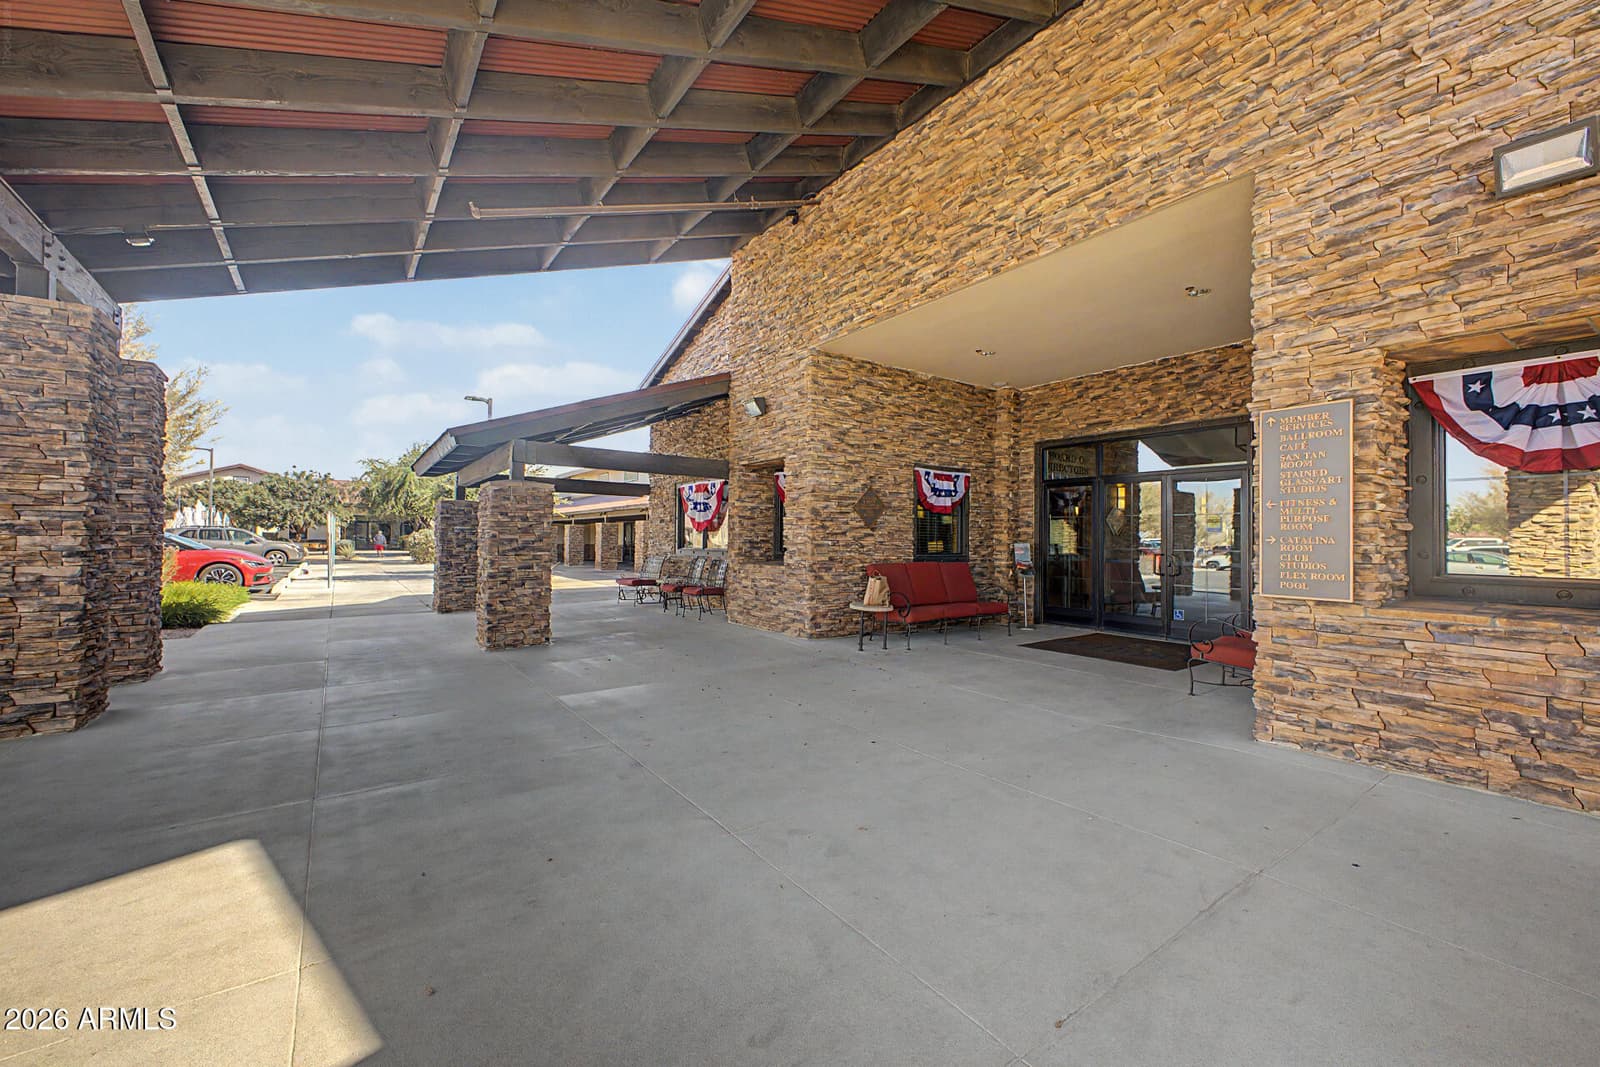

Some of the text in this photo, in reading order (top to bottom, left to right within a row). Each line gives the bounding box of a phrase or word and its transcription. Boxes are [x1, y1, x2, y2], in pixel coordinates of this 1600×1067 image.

[1280, 412, 1329, 424] MEMBER
[1280, 419, 1333, 432] SERVICES
[1280, 428, 1344, 441] BALLROOM
[1280, 450, 1327, 461] SAN TAN
[1280, 460, 1313, 469] ROOM
[1280, 468, 1328, 478] STAINED
[1280, 484, 1327, 494] STUDIOS
[1280, 497, 1337, 507] FITNESS &
[1280, 514, 1330, 523] PURPOSE
[1280, 523, 1313, 531] ROOM
[1280, 536, 1336, 545] CATALINA
[1280, 544, 1313, 552] ROOM
[1280, 554, 1310, 562] CLUB
[1280, 561, 1328, 570] STUDIOS
[1280, 571, 1345, 582] FLEX ROOM
[1280, 581, 1310, 590] POOL
